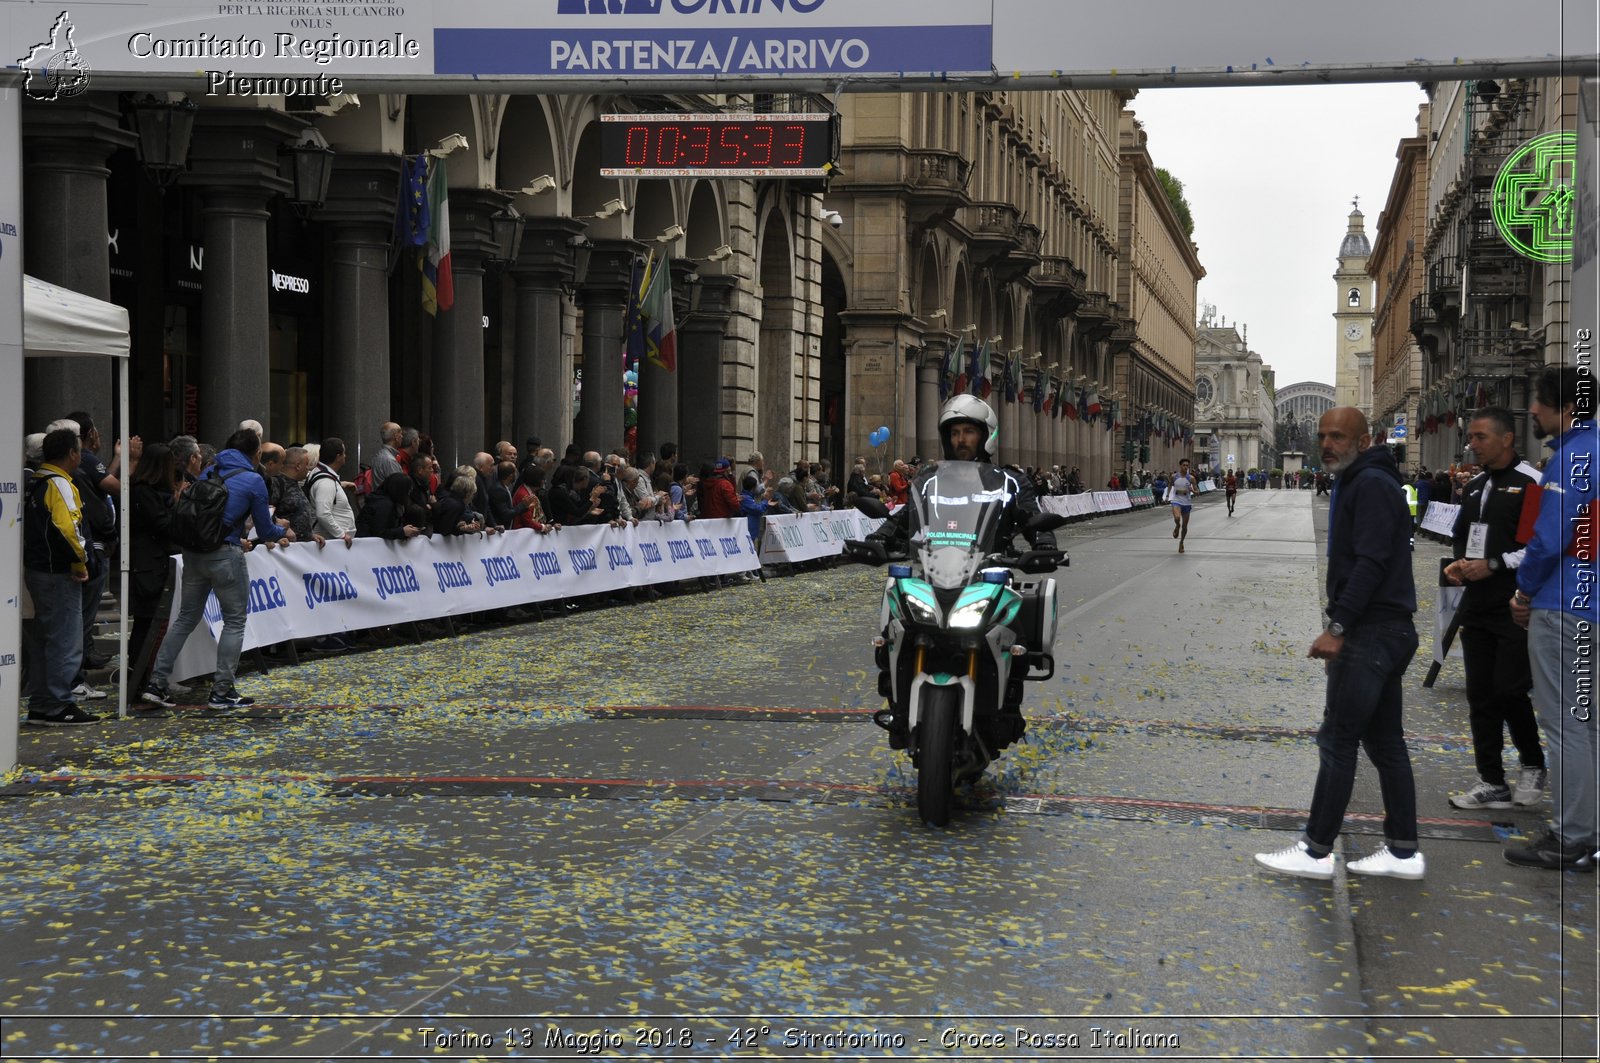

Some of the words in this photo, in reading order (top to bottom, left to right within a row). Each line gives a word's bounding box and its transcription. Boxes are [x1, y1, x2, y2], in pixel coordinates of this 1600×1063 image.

[218, 5, 243, 15] PER
[246, 5, 262, 15] LA
[266, 5, 323, 16] RICERCA
[325, 6, 350, 16] SUL
[352, 6, 405, 17] CANCRO
[290, 19, 332, 29] ONLUS
[550, 36, 869, 73] PARTENZA/ARRIVO
[625, 126, 805, 165] 00:35:33
[271, 269, 310, 294] NESPRESSO
